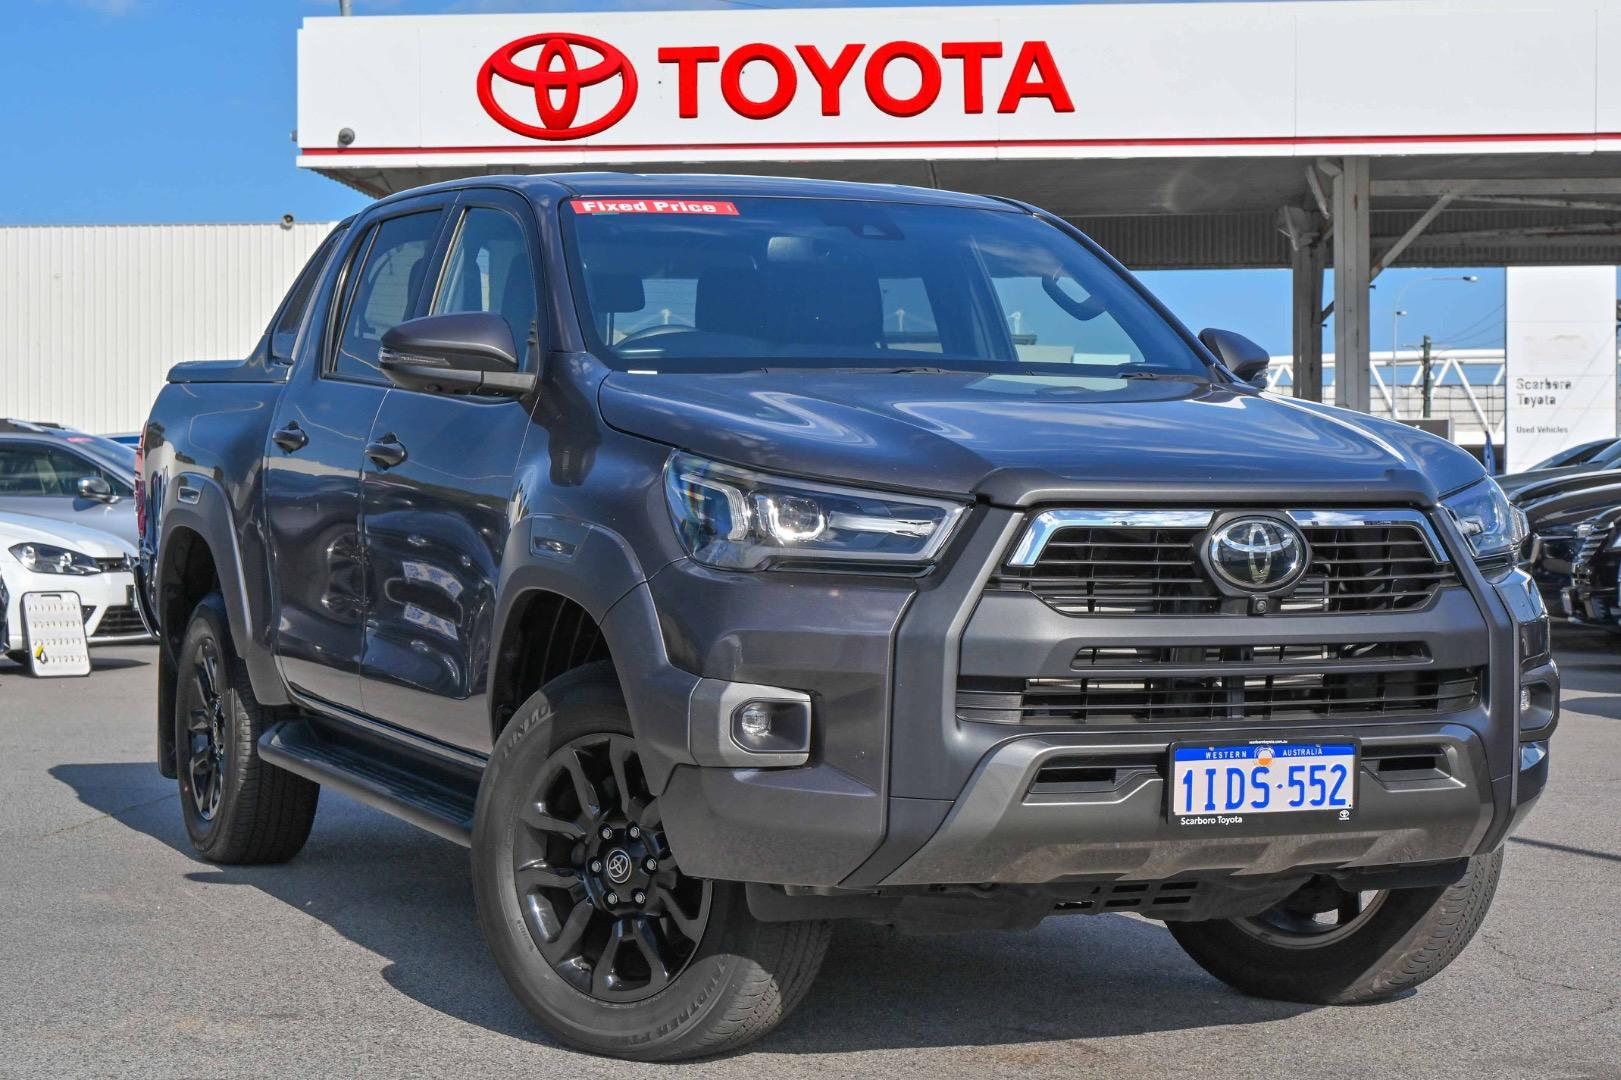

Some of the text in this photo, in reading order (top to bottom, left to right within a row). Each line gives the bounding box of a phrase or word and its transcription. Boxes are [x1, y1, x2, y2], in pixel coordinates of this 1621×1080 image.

[658, 41, 1075, 119] TOYOTA
[582, 201, 717, 213] Fixed Price
[1516, 393, 1556, 408] Toyota
[1205, 747, 1323, 759] WESTERN AUSTRALIA
[1180, 815, 1243, 826] Scarboro Toyota
